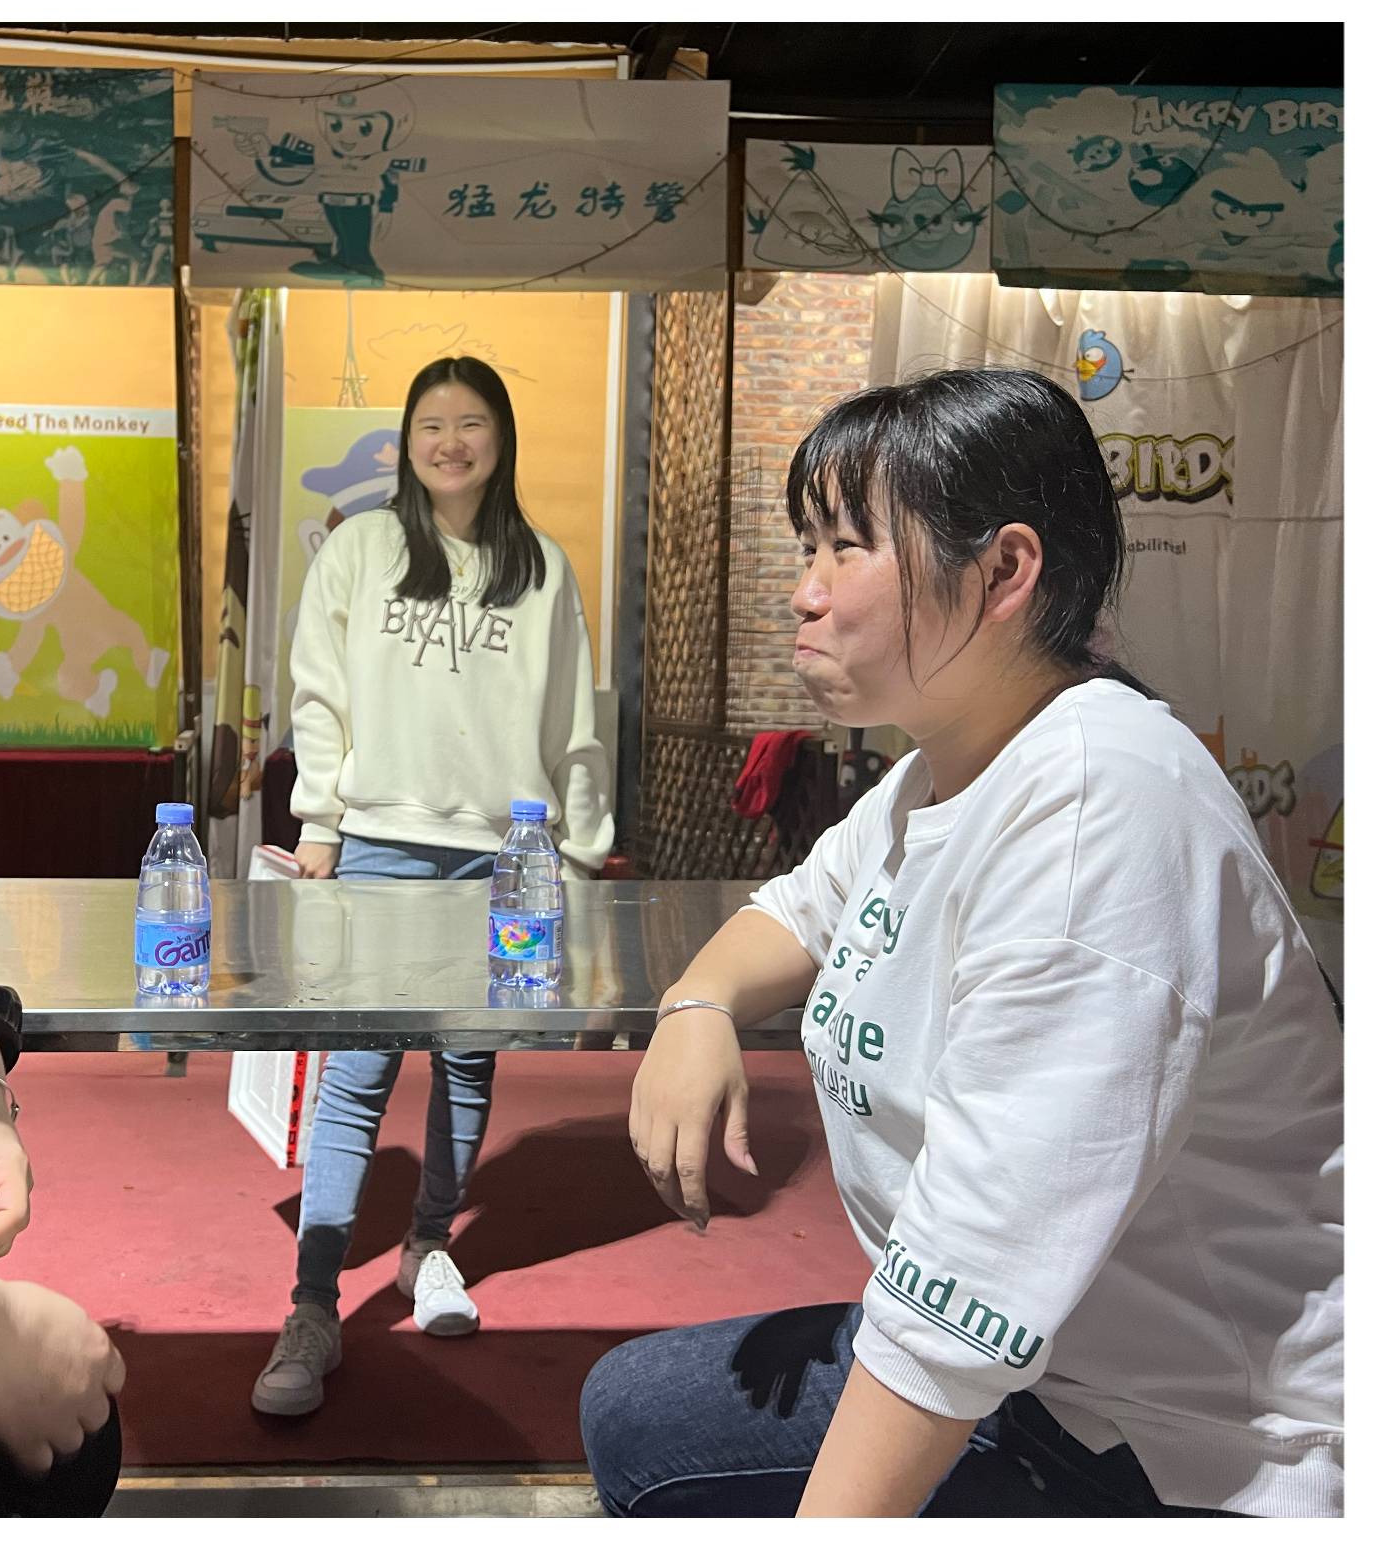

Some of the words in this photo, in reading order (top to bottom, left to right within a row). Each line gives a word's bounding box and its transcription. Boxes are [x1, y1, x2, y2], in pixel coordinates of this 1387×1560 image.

[1131, 95, 1257, 136] ANGRY
[442, 181, 683, 223] 猛龙特警
[34, 413, 68, 430] The
[74, 415, 151, 434] Monkey
[1100, 433, 1234, 503] BIRD
[380, 596, 512, 673] BRAVE
[859, 890, 909, 954] ey
[883, 1239, 957, 1315] find
[960, 1297, 1045, 1369] my
